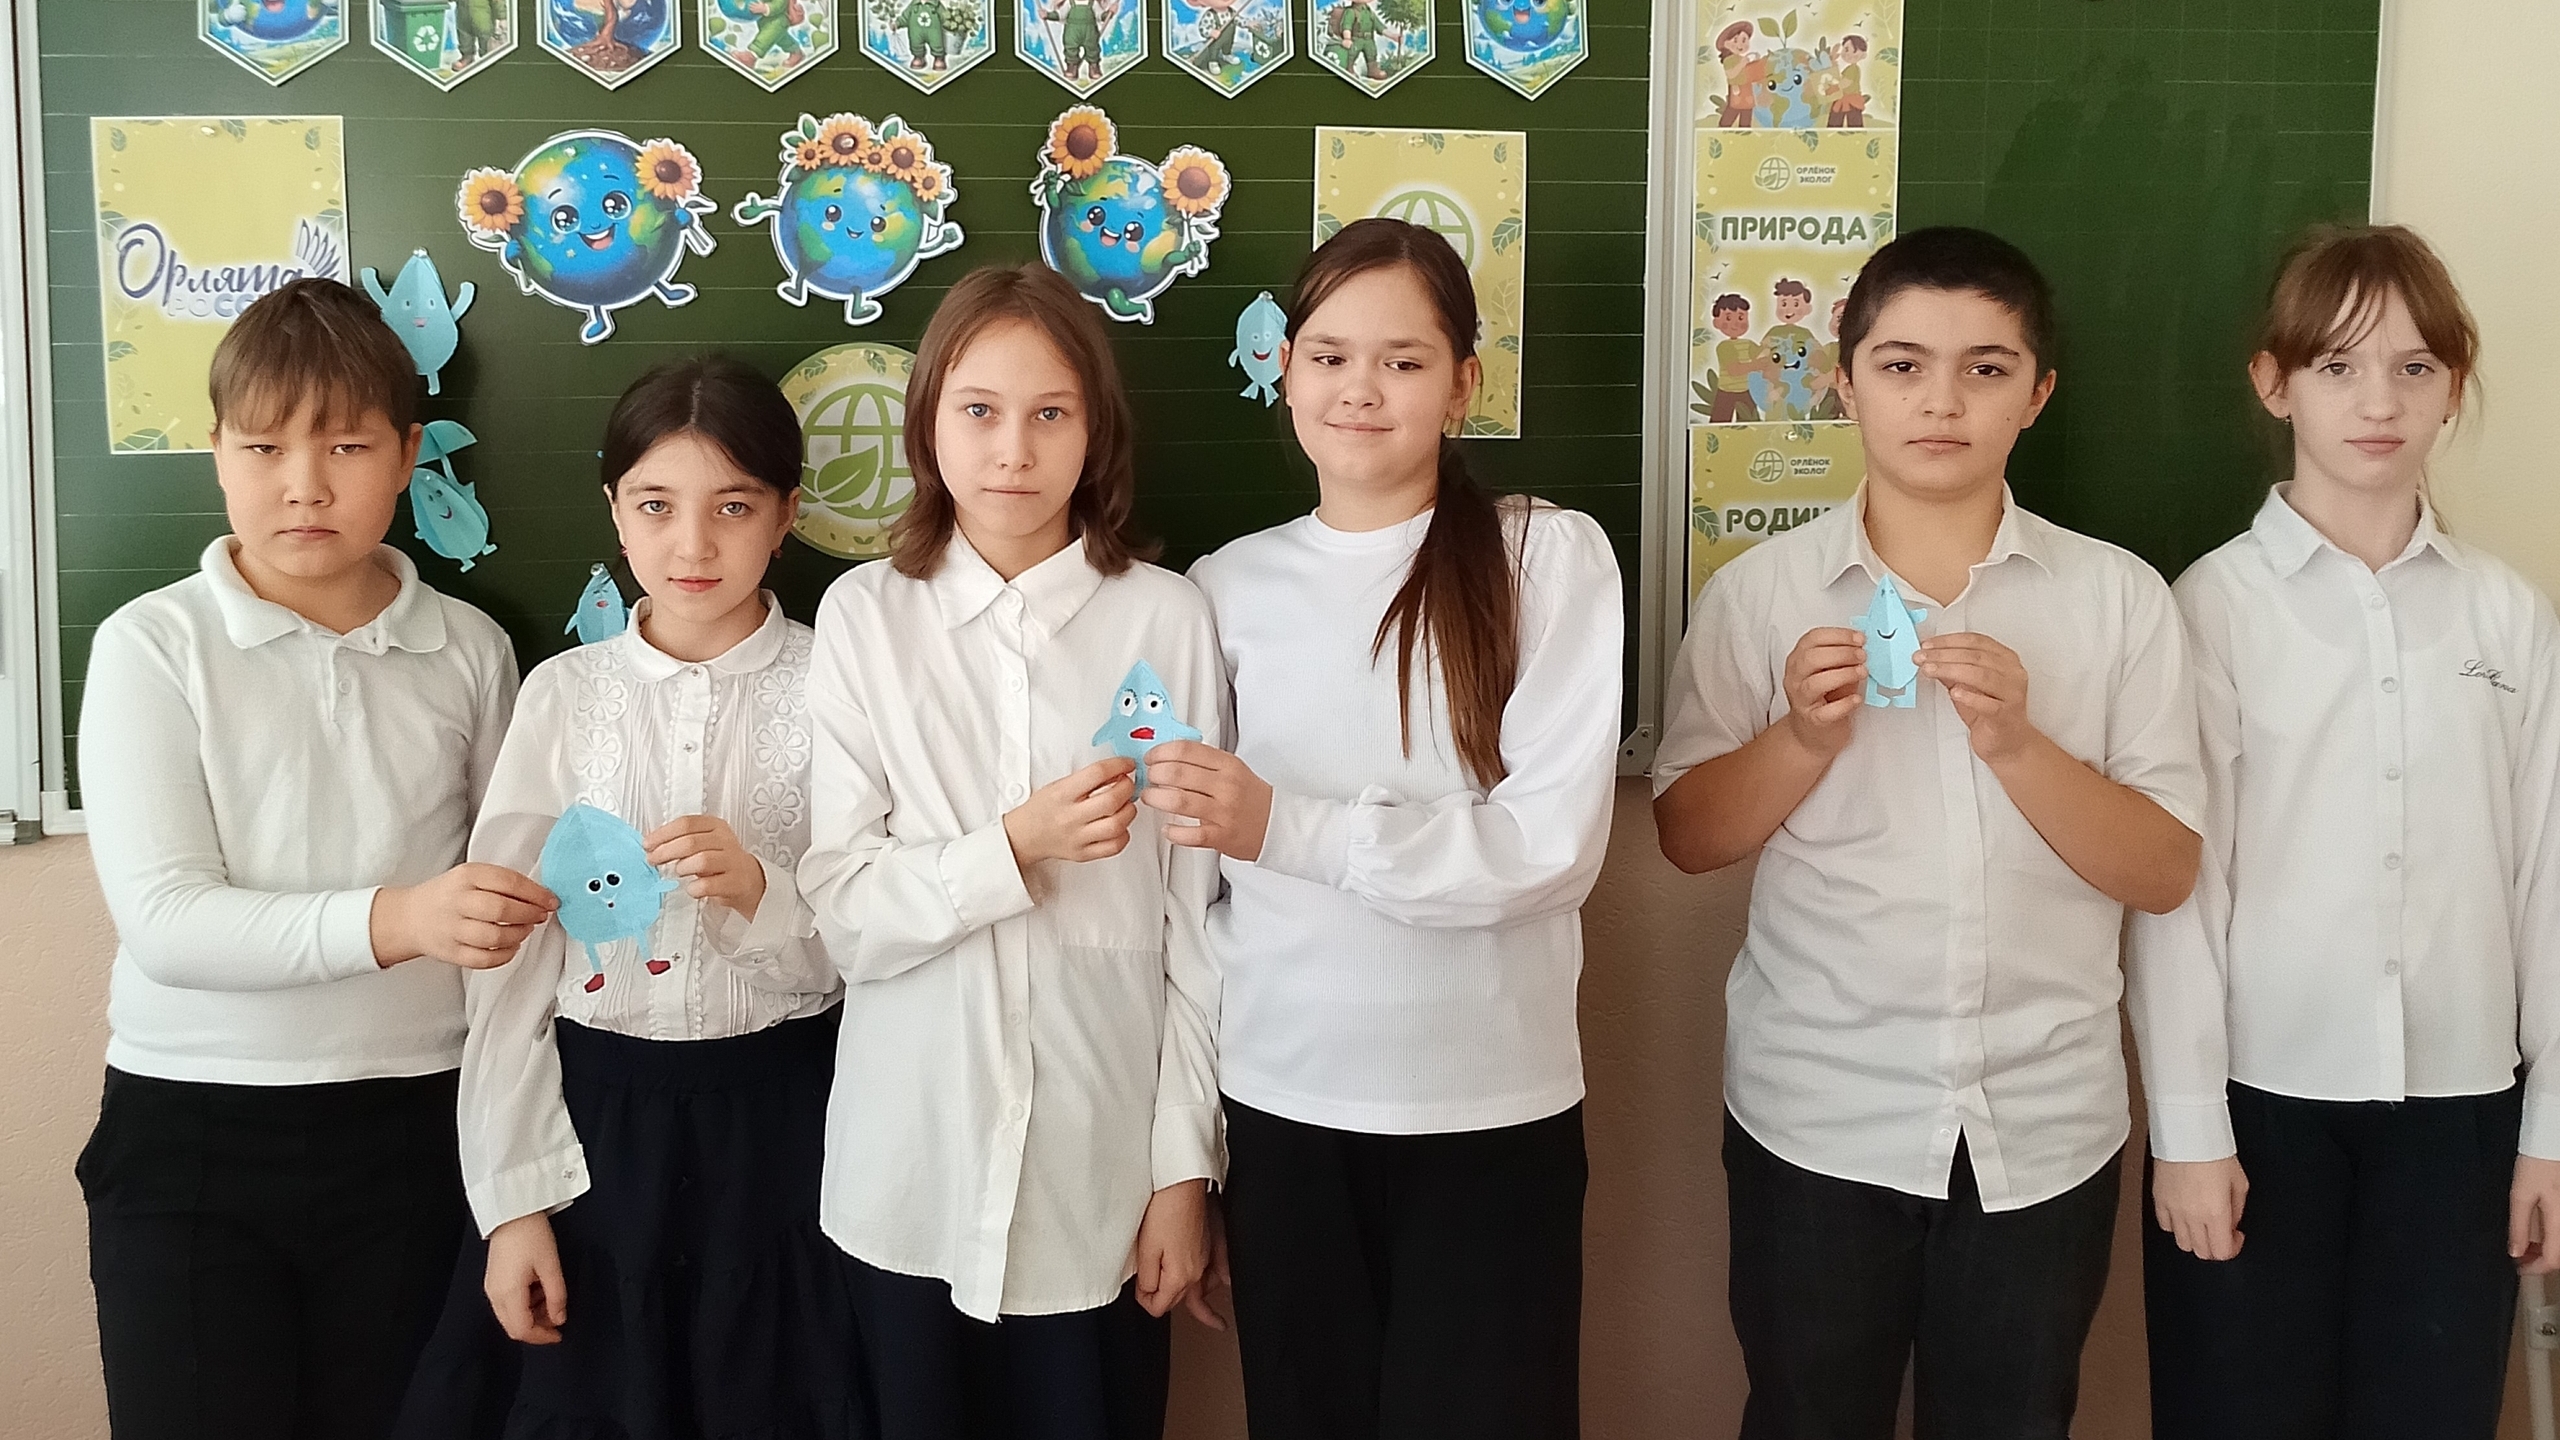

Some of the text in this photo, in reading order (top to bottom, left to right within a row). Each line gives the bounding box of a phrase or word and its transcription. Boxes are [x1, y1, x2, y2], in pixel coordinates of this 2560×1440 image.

[1797, 167, 1836, 175] ОРЛЁНОК
[1800, 176, 1832, 184] ЭКОЛОГ
[1721, 217, 1867, 245] ПРИРОДА
[118, 223, 303, 307] Орлята
[167, 293, 264, 317] РОСС
[1790, 458, 1830, 467] ОРЛЁНОК
[1793, 467, 1827, 475] ЭКОЛОГ
